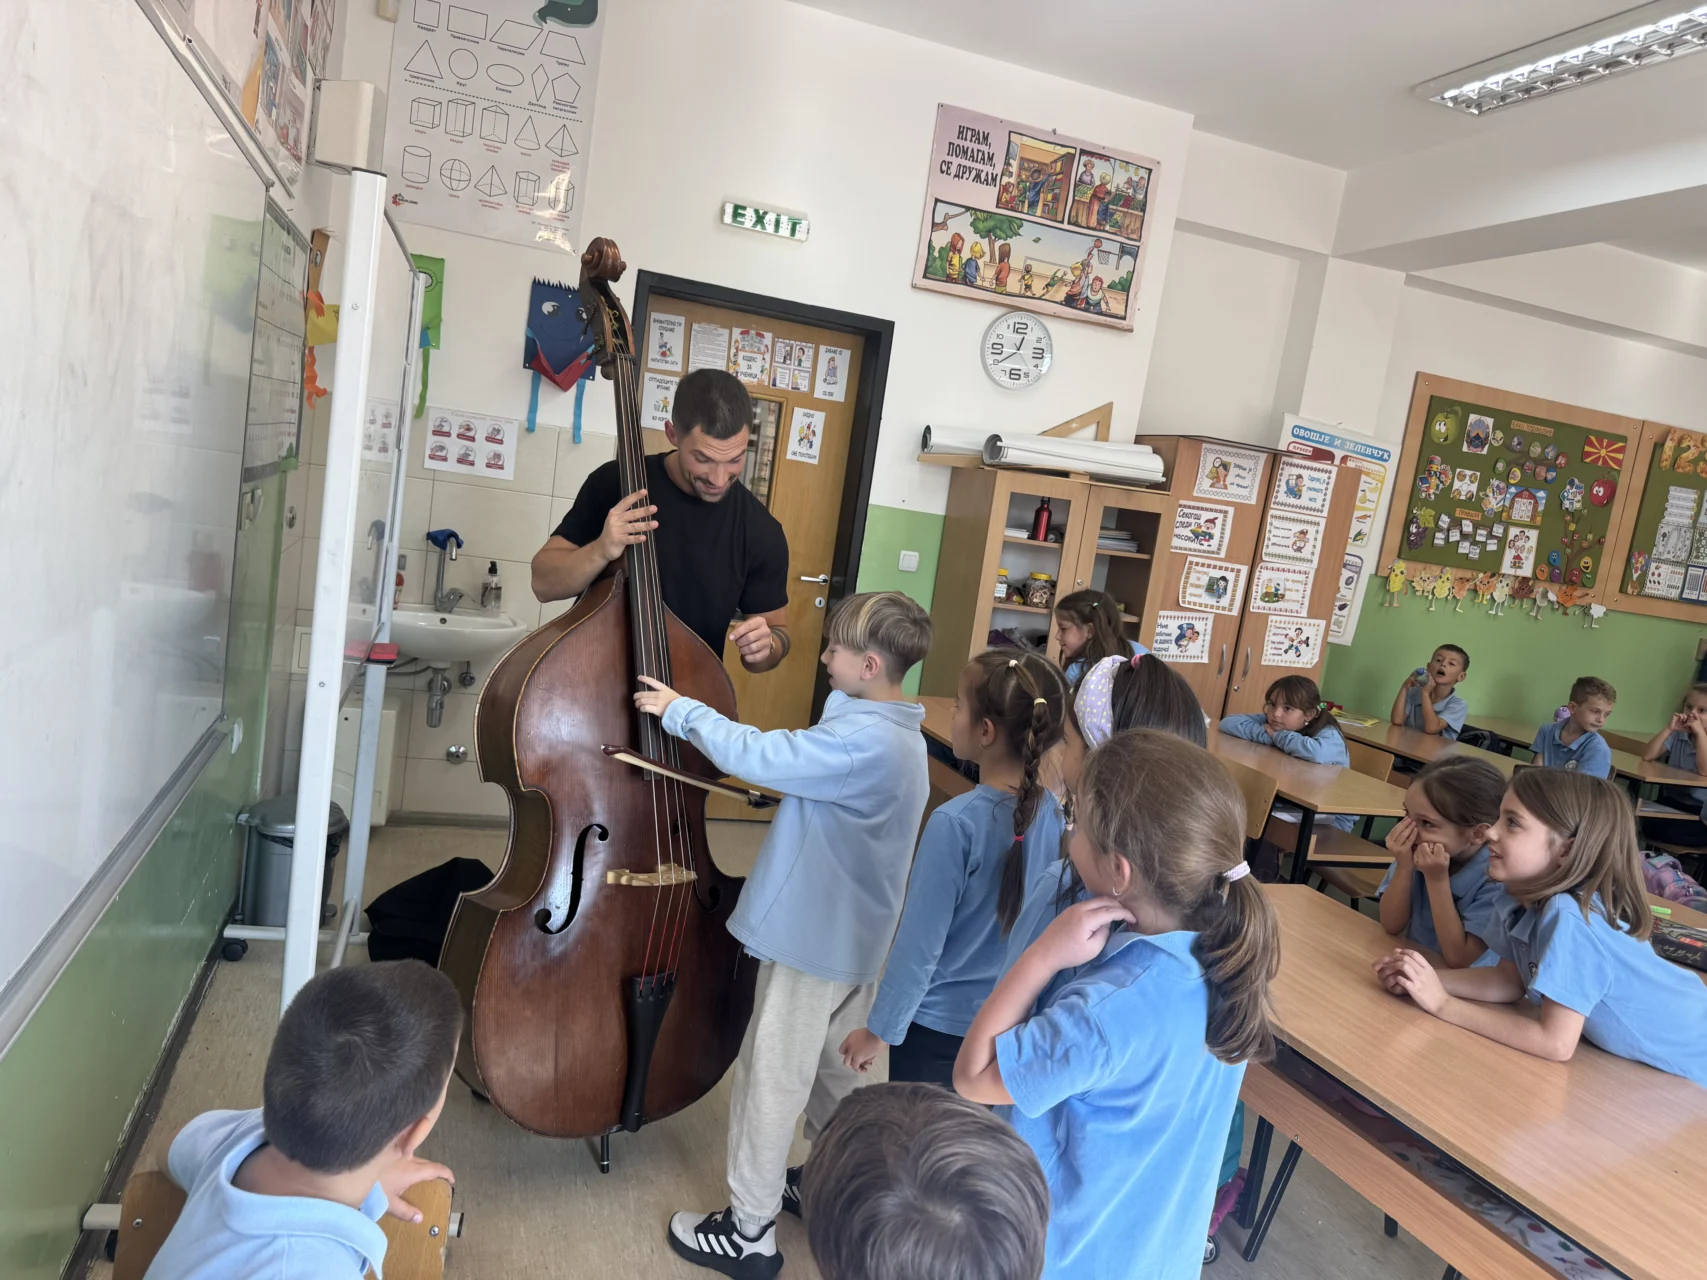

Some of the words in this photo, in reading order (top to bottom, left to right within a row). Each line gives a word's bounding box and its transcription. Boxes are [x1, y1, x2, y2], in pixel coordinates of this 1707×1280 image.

[957, 125, 991, 150] ИГРАМ,
[947, 141, 996, 171] ПОМАГАМ,
[940, 160, 953, 176] СЕ
[953, 163, 998, 188] ДРУЖАМ
[731, 203, 803, 237] EXIT
[1013, 321, 1028, 335] 12
[991, 342, 1004, 355] 9
[1032, 347, 1045, 360] 3
[742, 355, 758, 363] КОДЕКС
[1009, 368, 1022, 380] 6
[1293, 427, 1330, 444] ОВОШЈЕ
[1333, 438, 1341, 447] И
[1344, 441, 1390, 460] ЗЕЛЕНЧУК
[1178, 509, 1202, 521] Секогаш
[1175, 520, 1192, 529] следи
[1173, 533, 1205, 546] насоките
